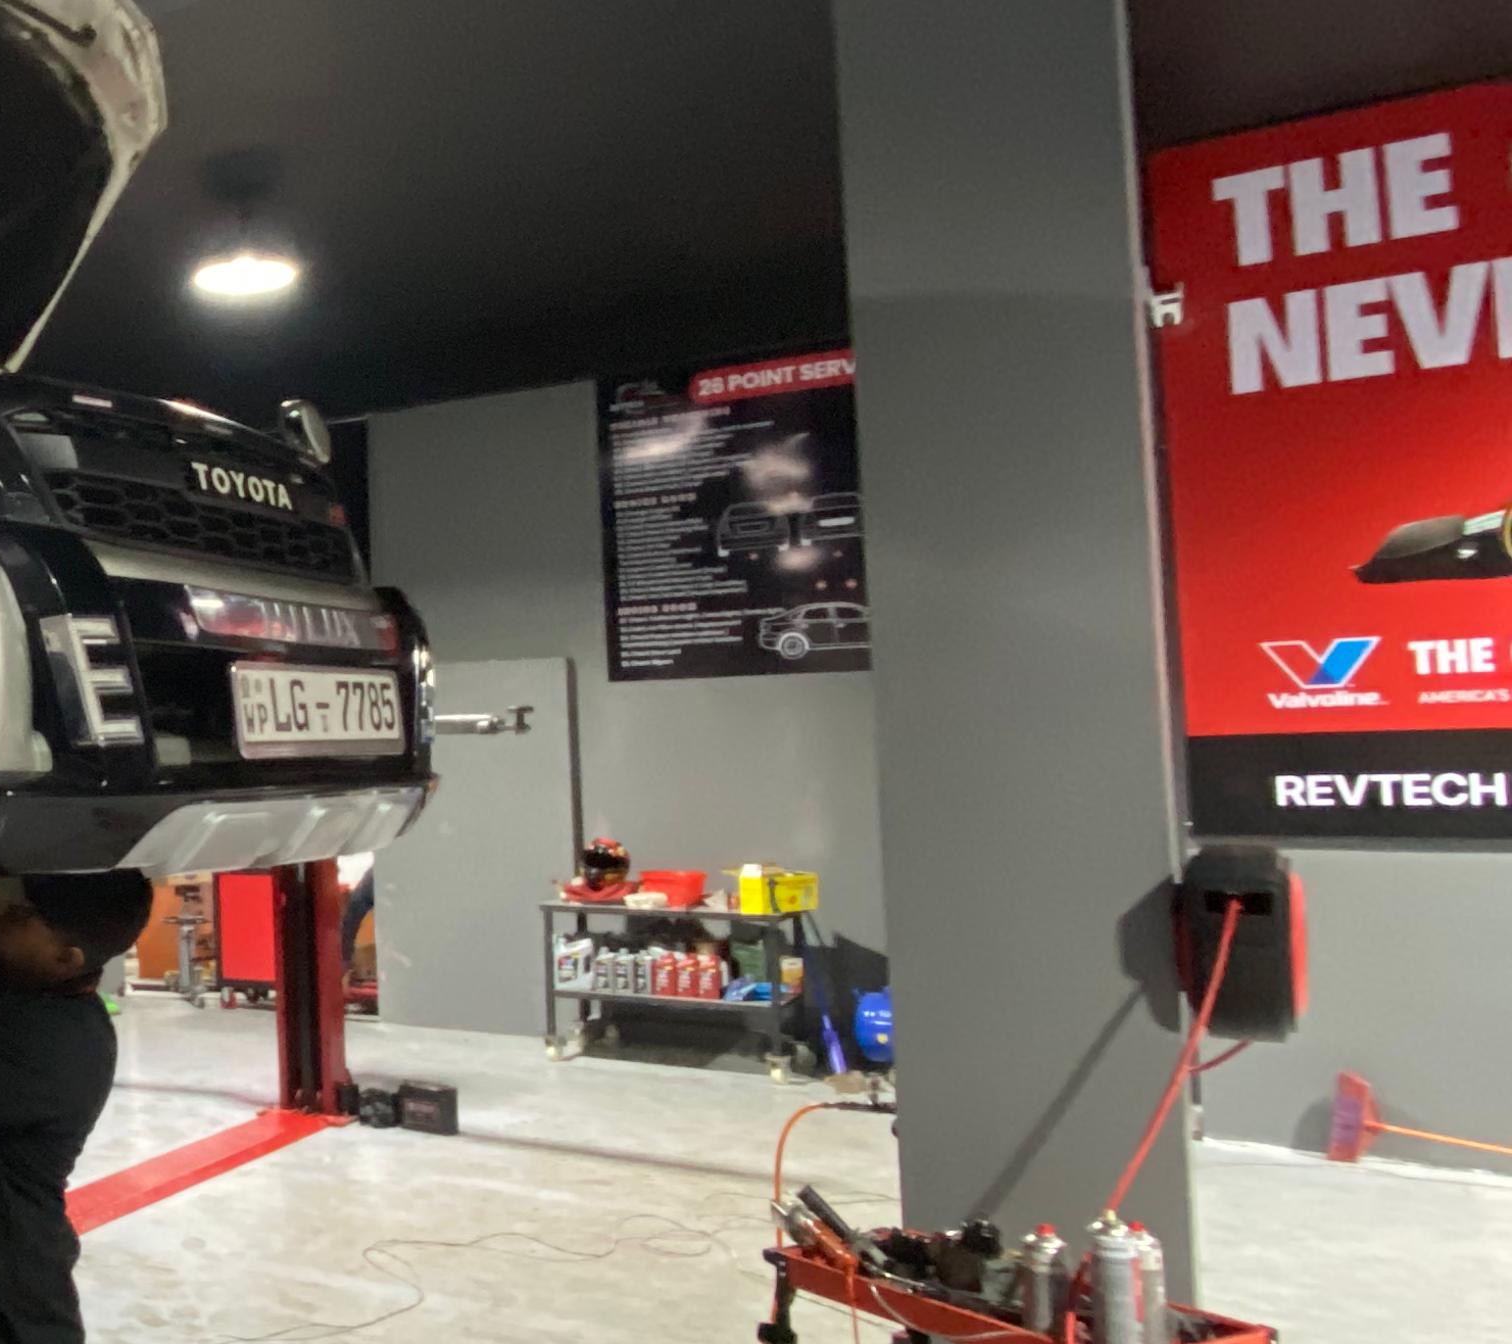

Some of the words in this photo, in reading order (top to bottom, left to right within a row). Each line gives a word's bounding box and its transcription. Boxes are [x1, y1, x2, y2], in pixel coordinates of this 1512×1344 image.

[1211, 132, 1460, 267] THE
[727, 366, 795, 392] POINT
[191, 461, 293, 510] TOYOTA
[1407, 637, 1496, 675] THE
[1267, 689, 1381, 709] Valvoline
[1417, 688, 1510, 704] AMERICA'S
[243, 703, 268, 734] WP
[1274, 772, 1508, 807] REVTECH
